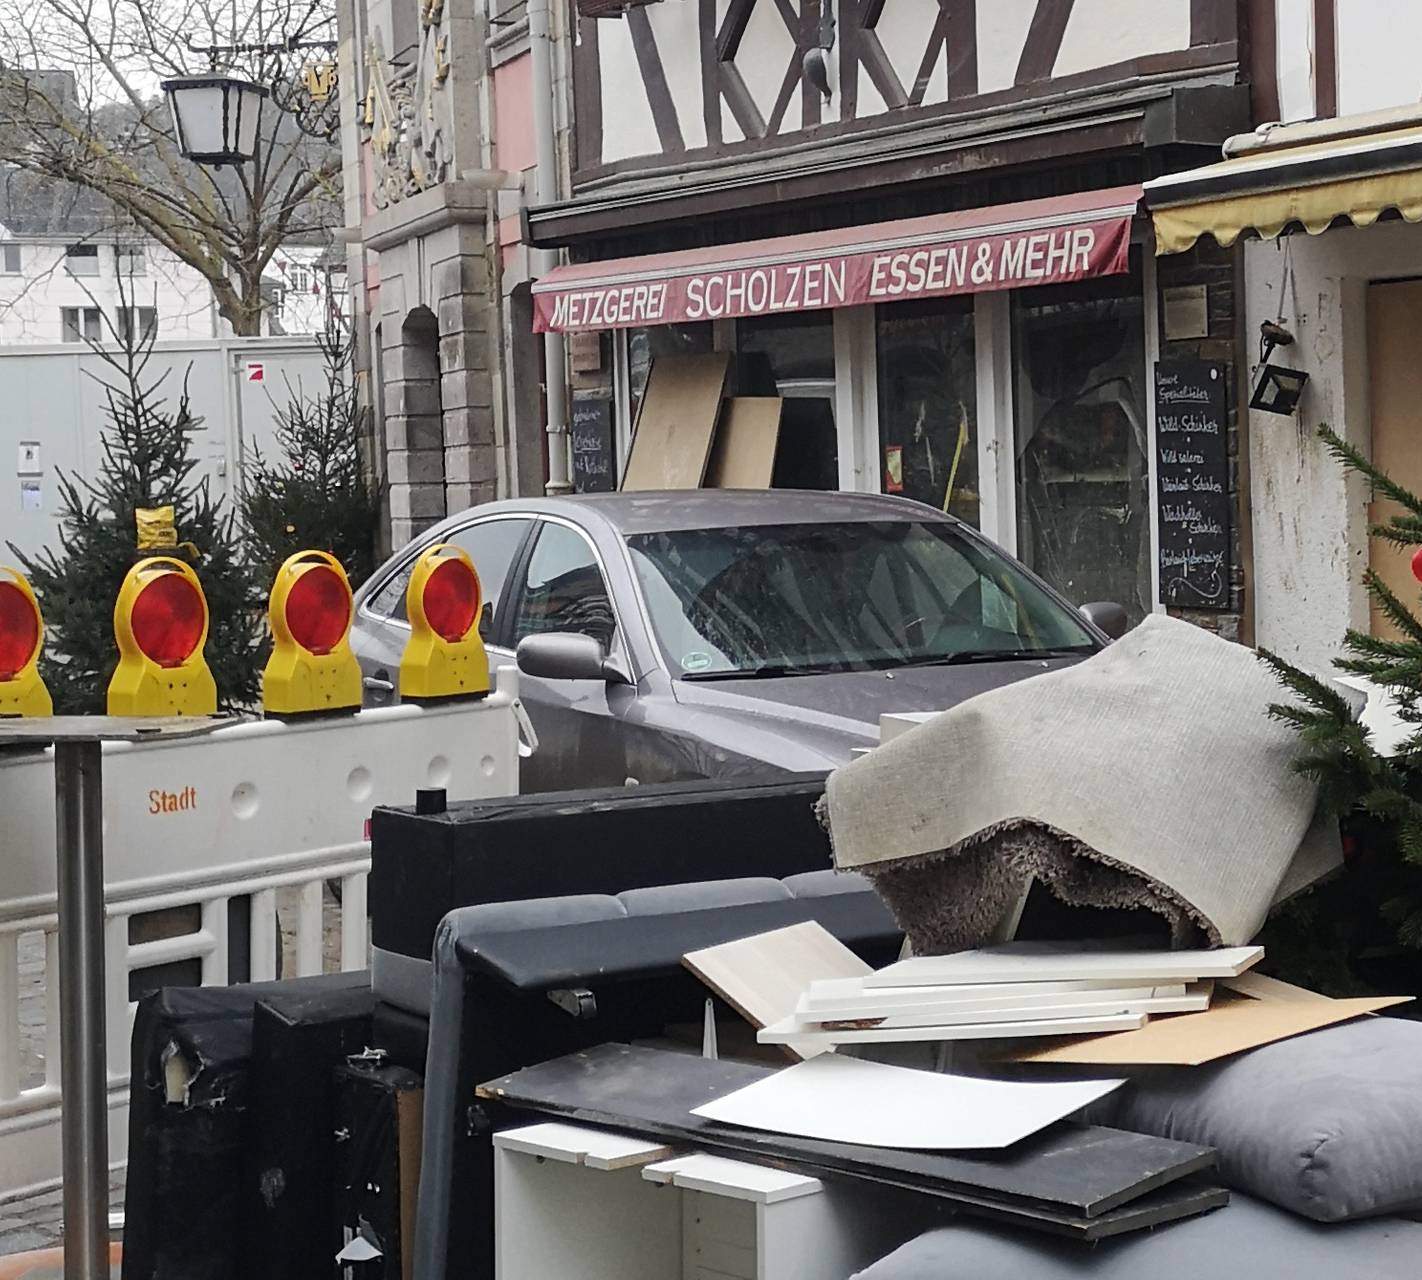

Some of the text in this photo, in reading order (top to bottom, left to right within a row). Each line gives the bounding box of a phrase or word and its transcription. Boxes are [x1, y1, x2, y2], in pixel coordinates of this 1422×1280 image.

[549, 227, 1096, 329] METZGEREI SCHOLZEN ESSEN & MEHR
[148, 785, 197, 815] Stadt
